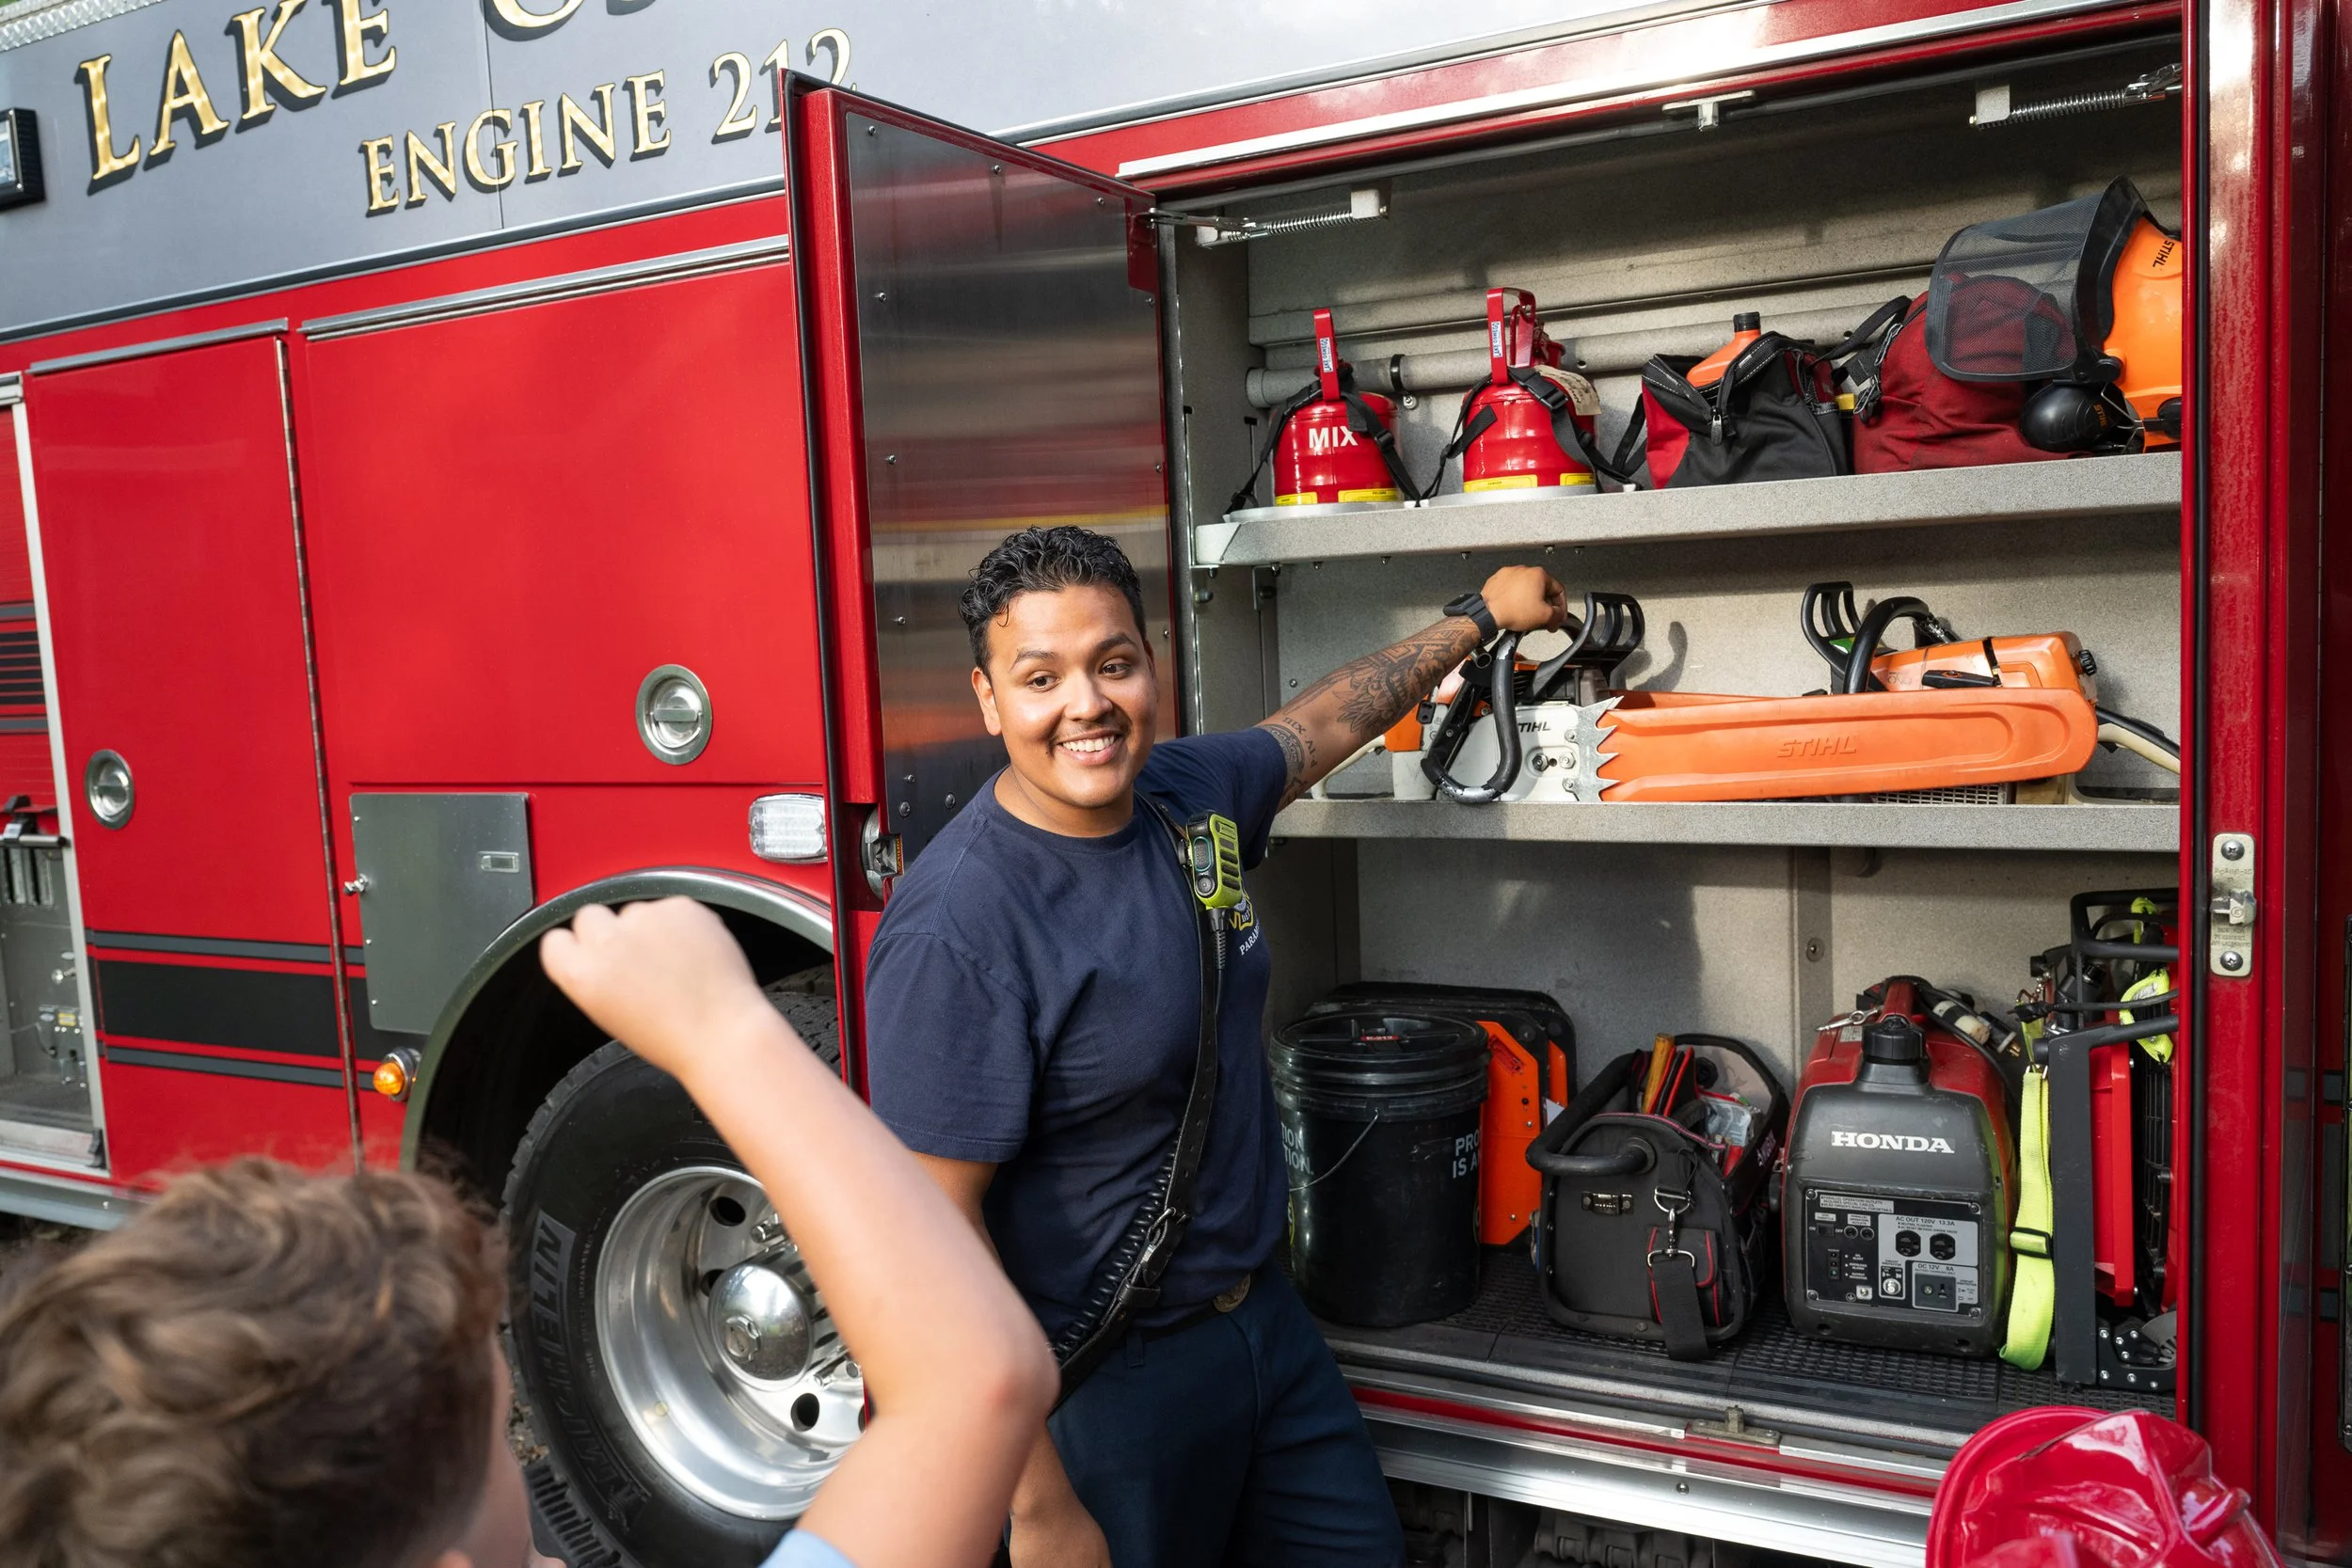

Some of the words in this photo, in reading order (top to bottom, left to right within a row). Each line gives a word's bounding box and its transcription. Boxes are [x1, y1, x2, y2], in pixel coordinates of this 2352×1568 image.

[77, 0, 397, 182] LAKE
[361, 69, 671, 213] ENGINE
[712, 27, 858, 137] 212
[2152, 239, 2175, 268] STIHL
[2092, 404, 2107, 429] STIHL
[1309, 425, 1359, 449] MIX
[1517, 721, 1550, 733] TIHL
[1776, 736, 1857, 758] STIHL
[1280, 1120, 1305, 1152] TION
[1455, 1128, 1480, 1157] PRO
[1831, 1131, 1955, 1154] HONDA
[1282, 1141, 1313, 1176] TION.
[1453, 1157, 1467, 1179] IS
